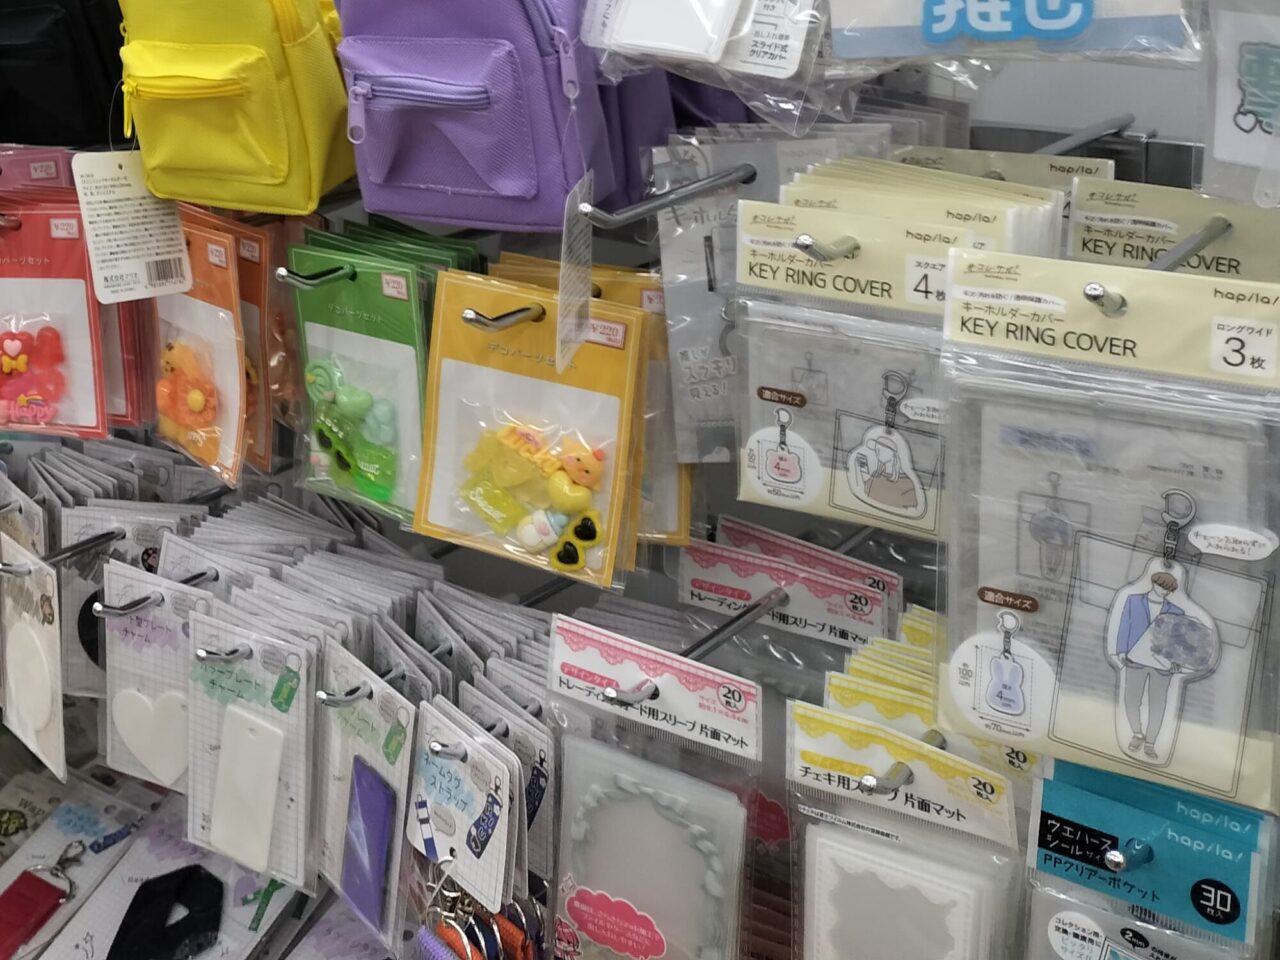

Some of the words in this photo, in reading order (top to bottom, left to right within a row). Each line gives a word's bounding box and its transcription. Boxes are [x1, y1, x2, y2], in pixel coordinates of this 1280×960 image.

[1081, 237, 1117, 257] KEY
[749, 248, 833, 268] キーホルダーカバー
[914, 260, 946, 271] スクエア
[748, 261, 779, 280] KEY
[785, 268, 827, 289] RING
[832, 275, 893, 299] COVER
[962, 301, 1065, 324] キーホルダーカバー
[590, 323, 619, 338] ¥220
[960, 316, 998, 337] KEY
[1006, 322, 1056, 347] RING
[1063, 330, 1137, 358] COVER
[1216, 322, 1273, 337] ロングワイド
[9, 403, 57, 425] Happy
[867, 577, 886, 591] 20
[849, 592, 868, 605] 20
[984, 590, 1032, 610] 適合サイズ
[690, 591, 826, 632] トレーディンード用スリーブ
[722, 685, 741, 702] 20
[559, 678, 696, 731] トレーディンード用スリーブ
[699, 724, 749, 750] 片面マット
[724, 700, 739, 710] 枚入
[1005, 745, 1027, 764] 20
[972, 778, 995, 796] 20
[904, 794, 966, 821] 片面マット
[1047, 818, 1112, 851] ウエハース
[1043, 853, 1160, 903] PPクリアーポケット
[1199, 884, 1232, 914] 30
